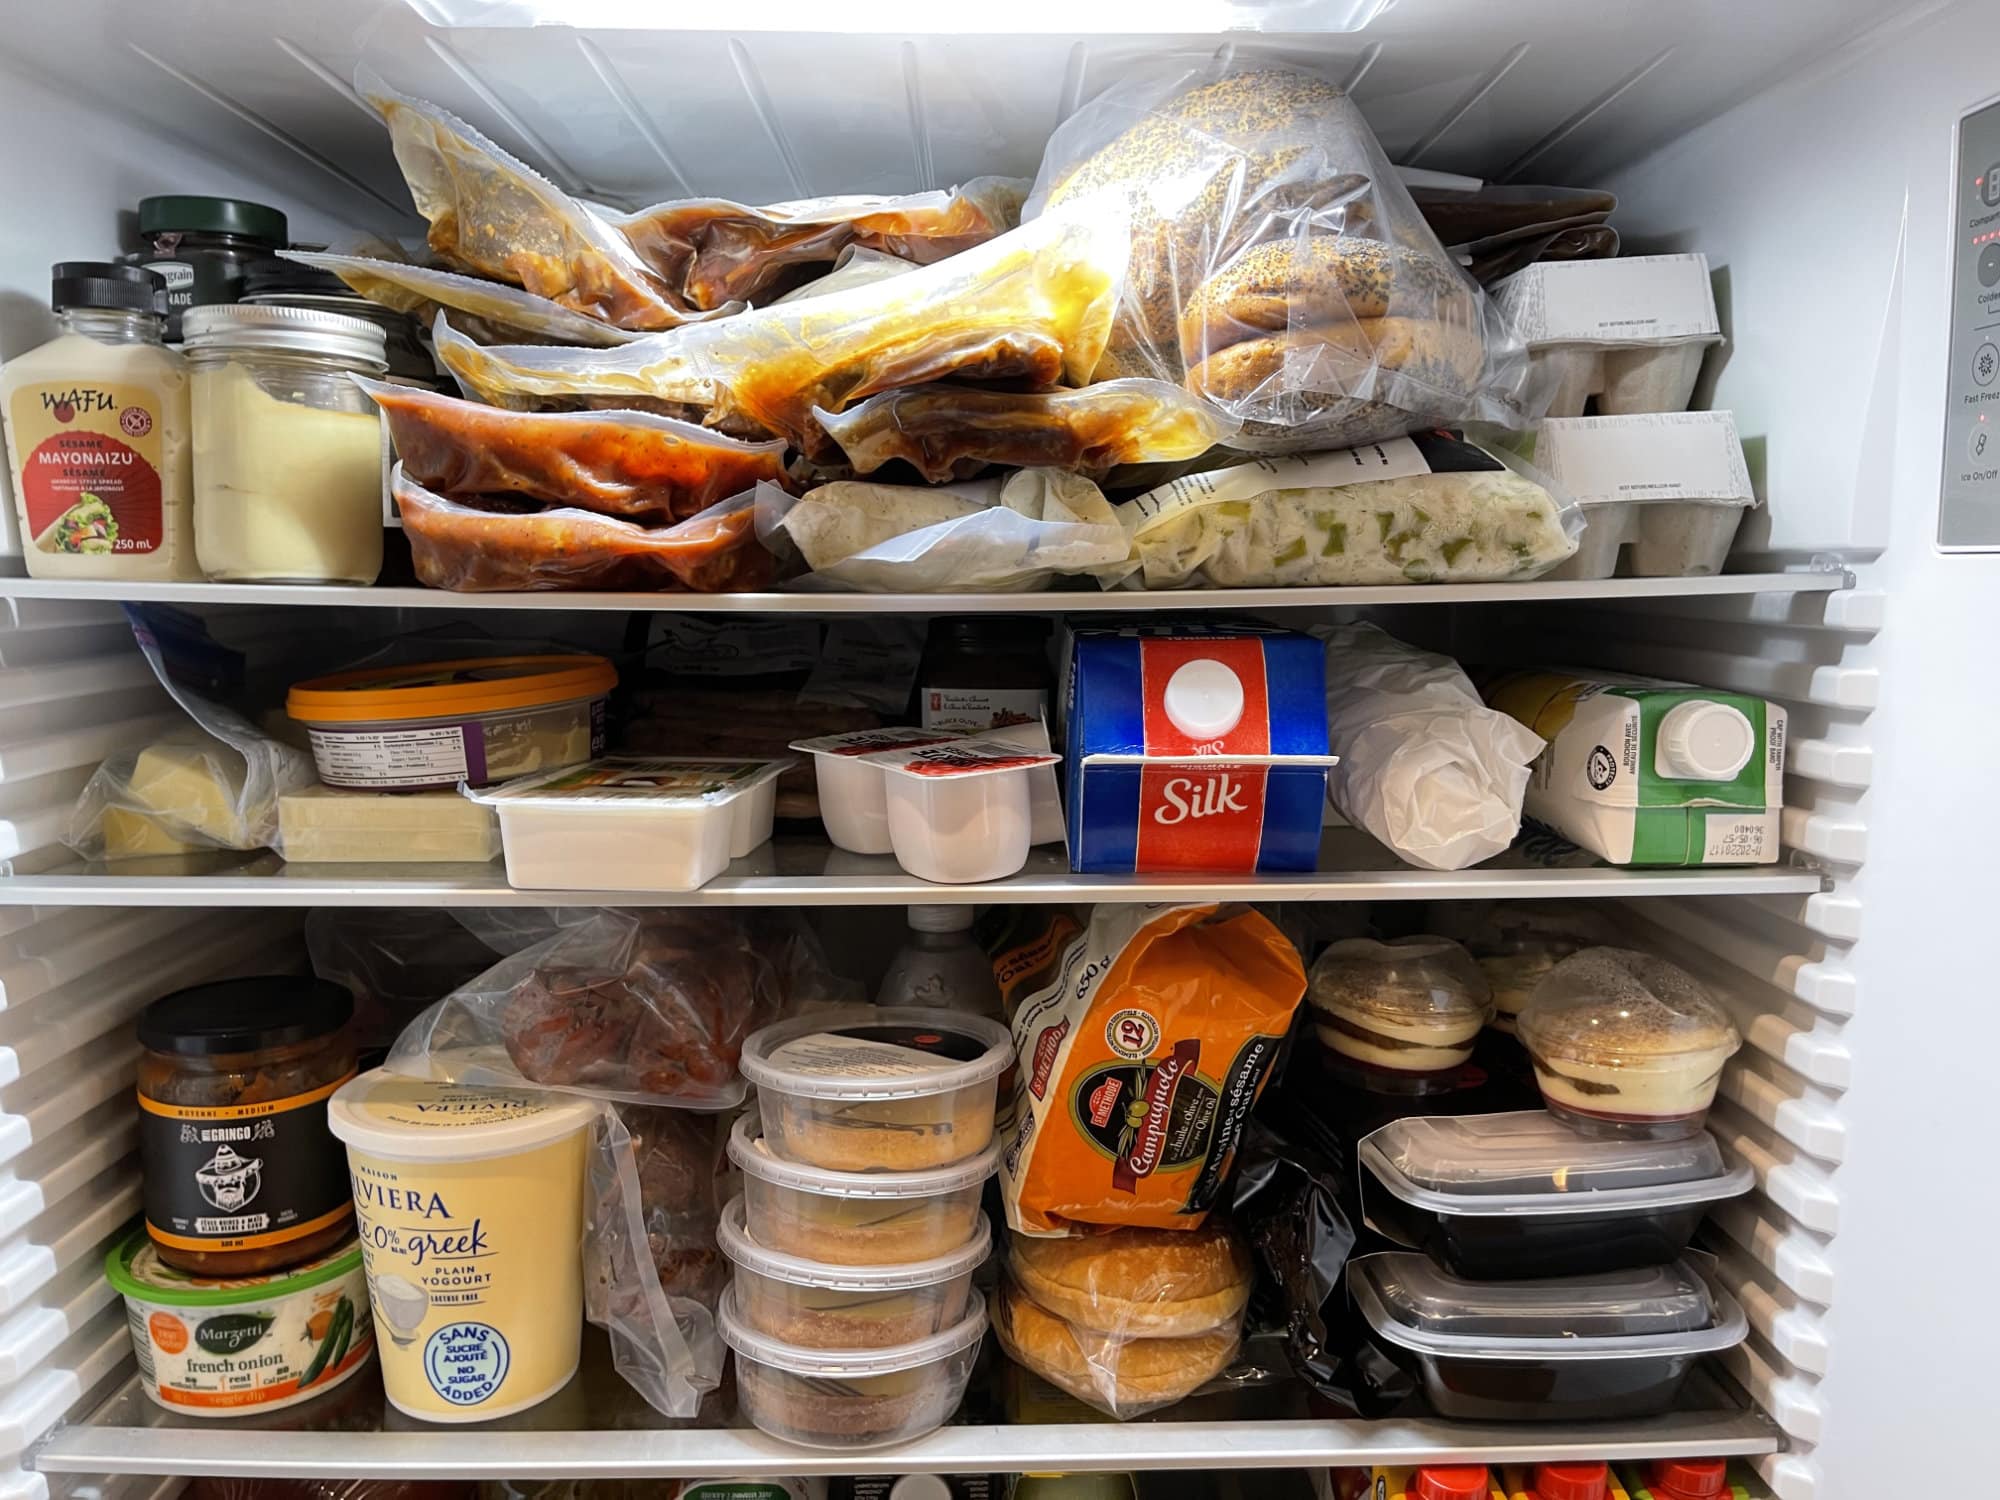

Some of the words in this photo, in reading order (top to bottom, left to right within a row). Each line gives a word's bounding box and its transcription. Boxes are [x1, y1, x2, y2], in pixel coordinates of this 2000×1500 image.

[40, 388, 114, 413] WAFU
[39, 452, 132, 465] MAYONAIZU
[115, 538, 134, 550] 250
[1154, 773, 1248, 824] Silk
[1076, 962, 1098, 1000] 650
[1231, 1043, 1264, 1106] sésame
[238, 1105, 274, 1116] MEDIUM
[1130, 1058, 1179, 1175] Campagnolo
[211, 1127, 250, 1142] GRINGO
[408, 1218, 488, 1266] greek
[435, 1266, 476, 1275] PLAIN
[421, 1273, 492, 1286] YOGOURT
[200, 1324, 262, 1348] Marzetti
[439, 1326, 490, 1344] SANS
[187, 1358, 234, 1374] french
[238, 1353, 283, 1370] onion
[444, 1350, 488, 1362] AJOUTÉ
[457, 1366, 474, 1374] NO
[229, 1374, 251, 1384] real
[448, 1374, 486, 1384] SUGAR
[441, 1381, 493, 1400] ADDED
